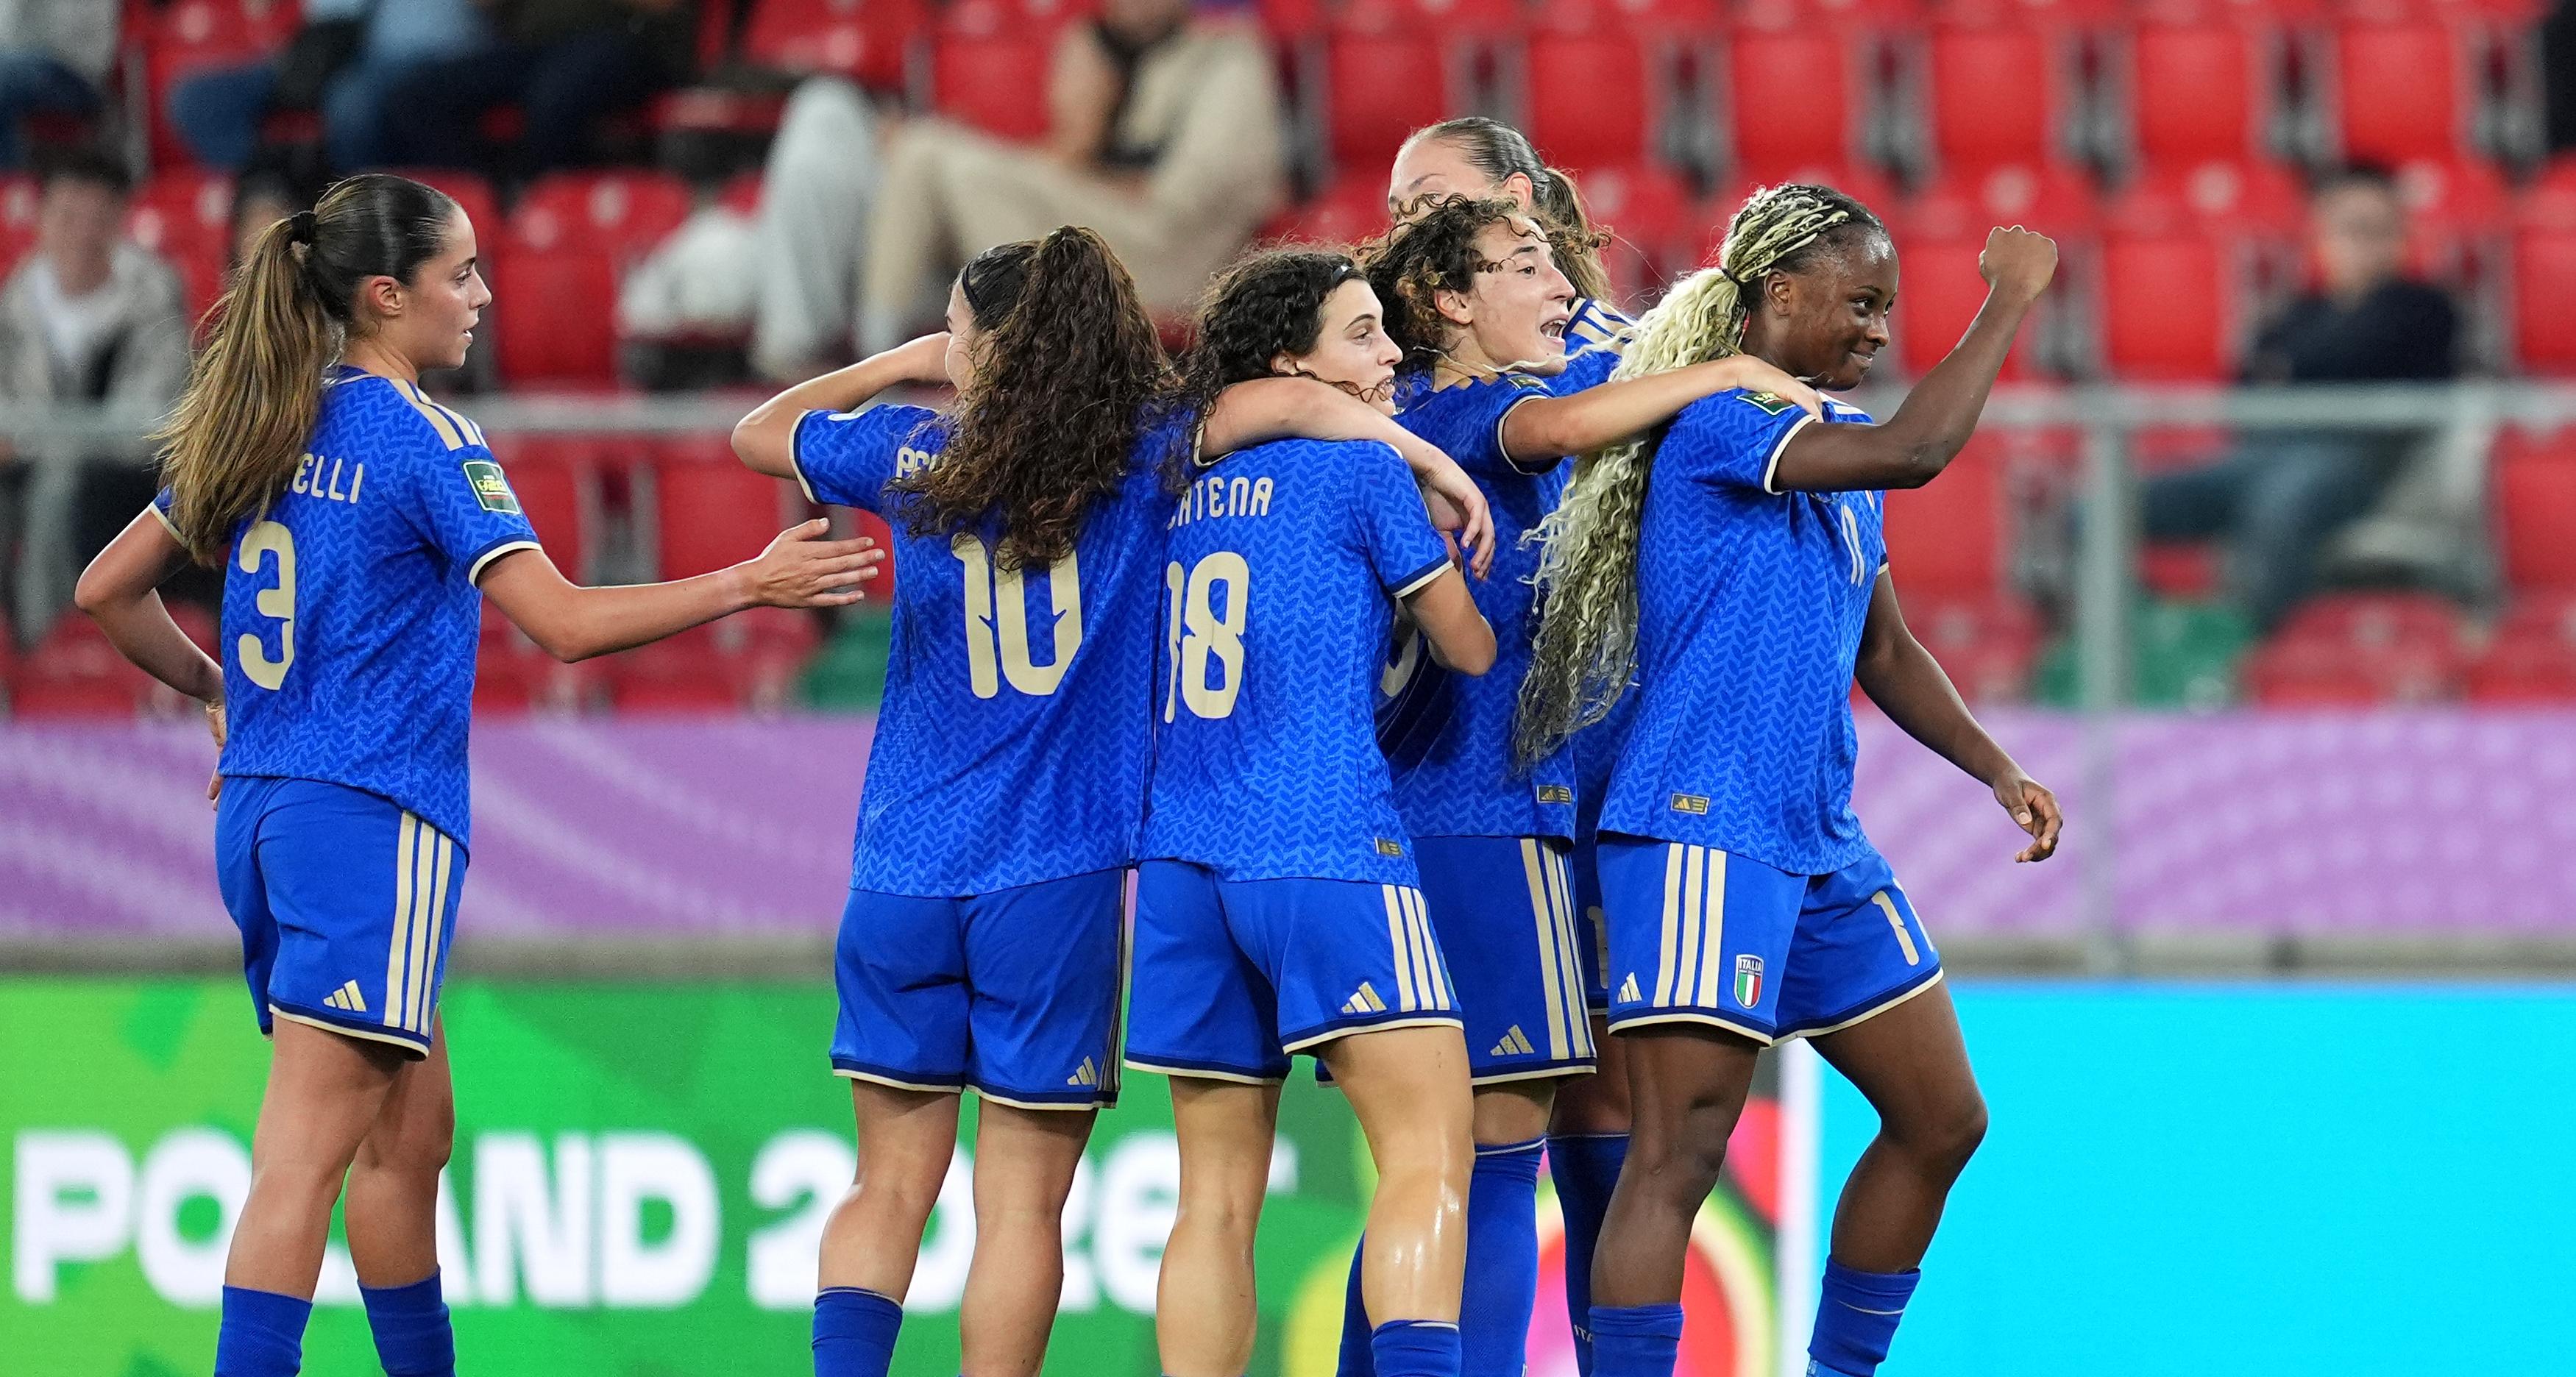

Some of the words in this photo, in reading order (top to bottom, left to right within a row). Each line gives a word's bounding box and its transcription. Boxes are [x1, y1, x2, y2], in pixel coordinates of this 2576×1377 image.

[284, 453, 363, 504] ELLI
[1167, 477, 1274, 530] ATENA
[239, 521, 296, 690] 3
[951, 532, 1082, 699] 10
[1166, 551, 1249, 724] 18
[1739, 958, 1762, 972] ITALIA
